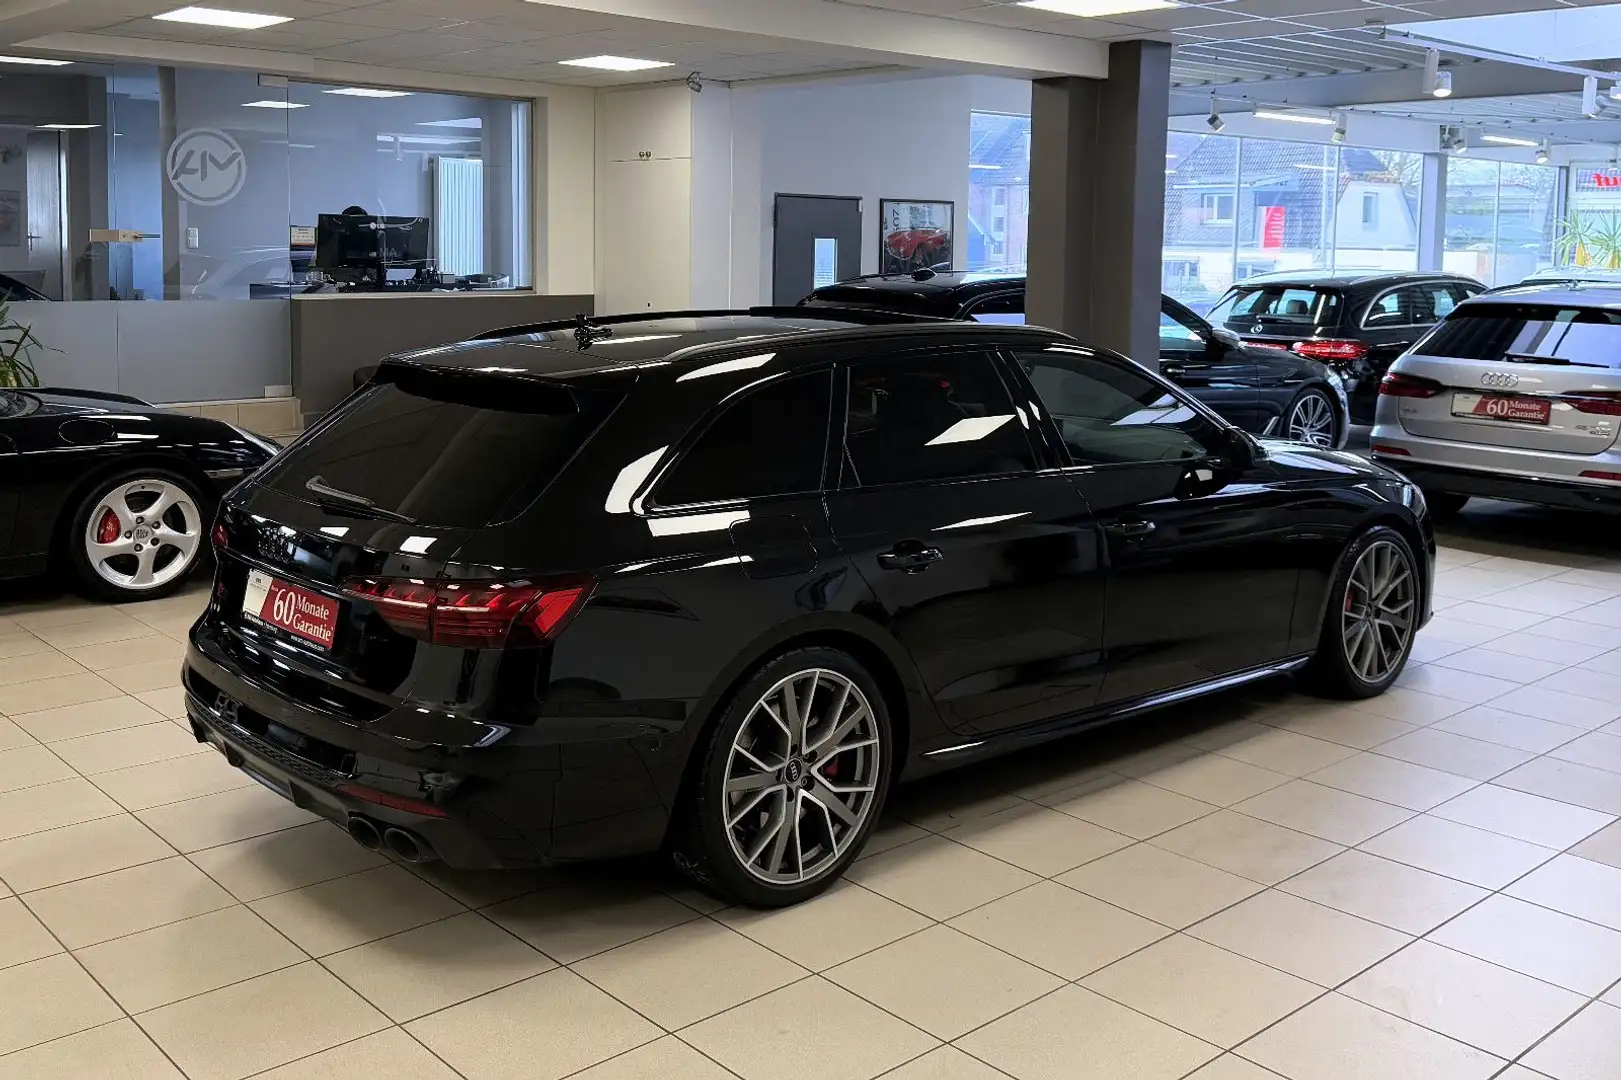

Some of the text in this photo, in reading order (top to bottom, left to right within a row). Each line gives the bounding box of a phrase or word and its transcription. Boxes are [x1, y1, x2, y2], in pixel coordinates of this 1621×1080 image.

[1486, 398, 1542, 416] 60 Monate
[273, 588, 296, 625] 60
[296, 593, 330, 620] Monate
